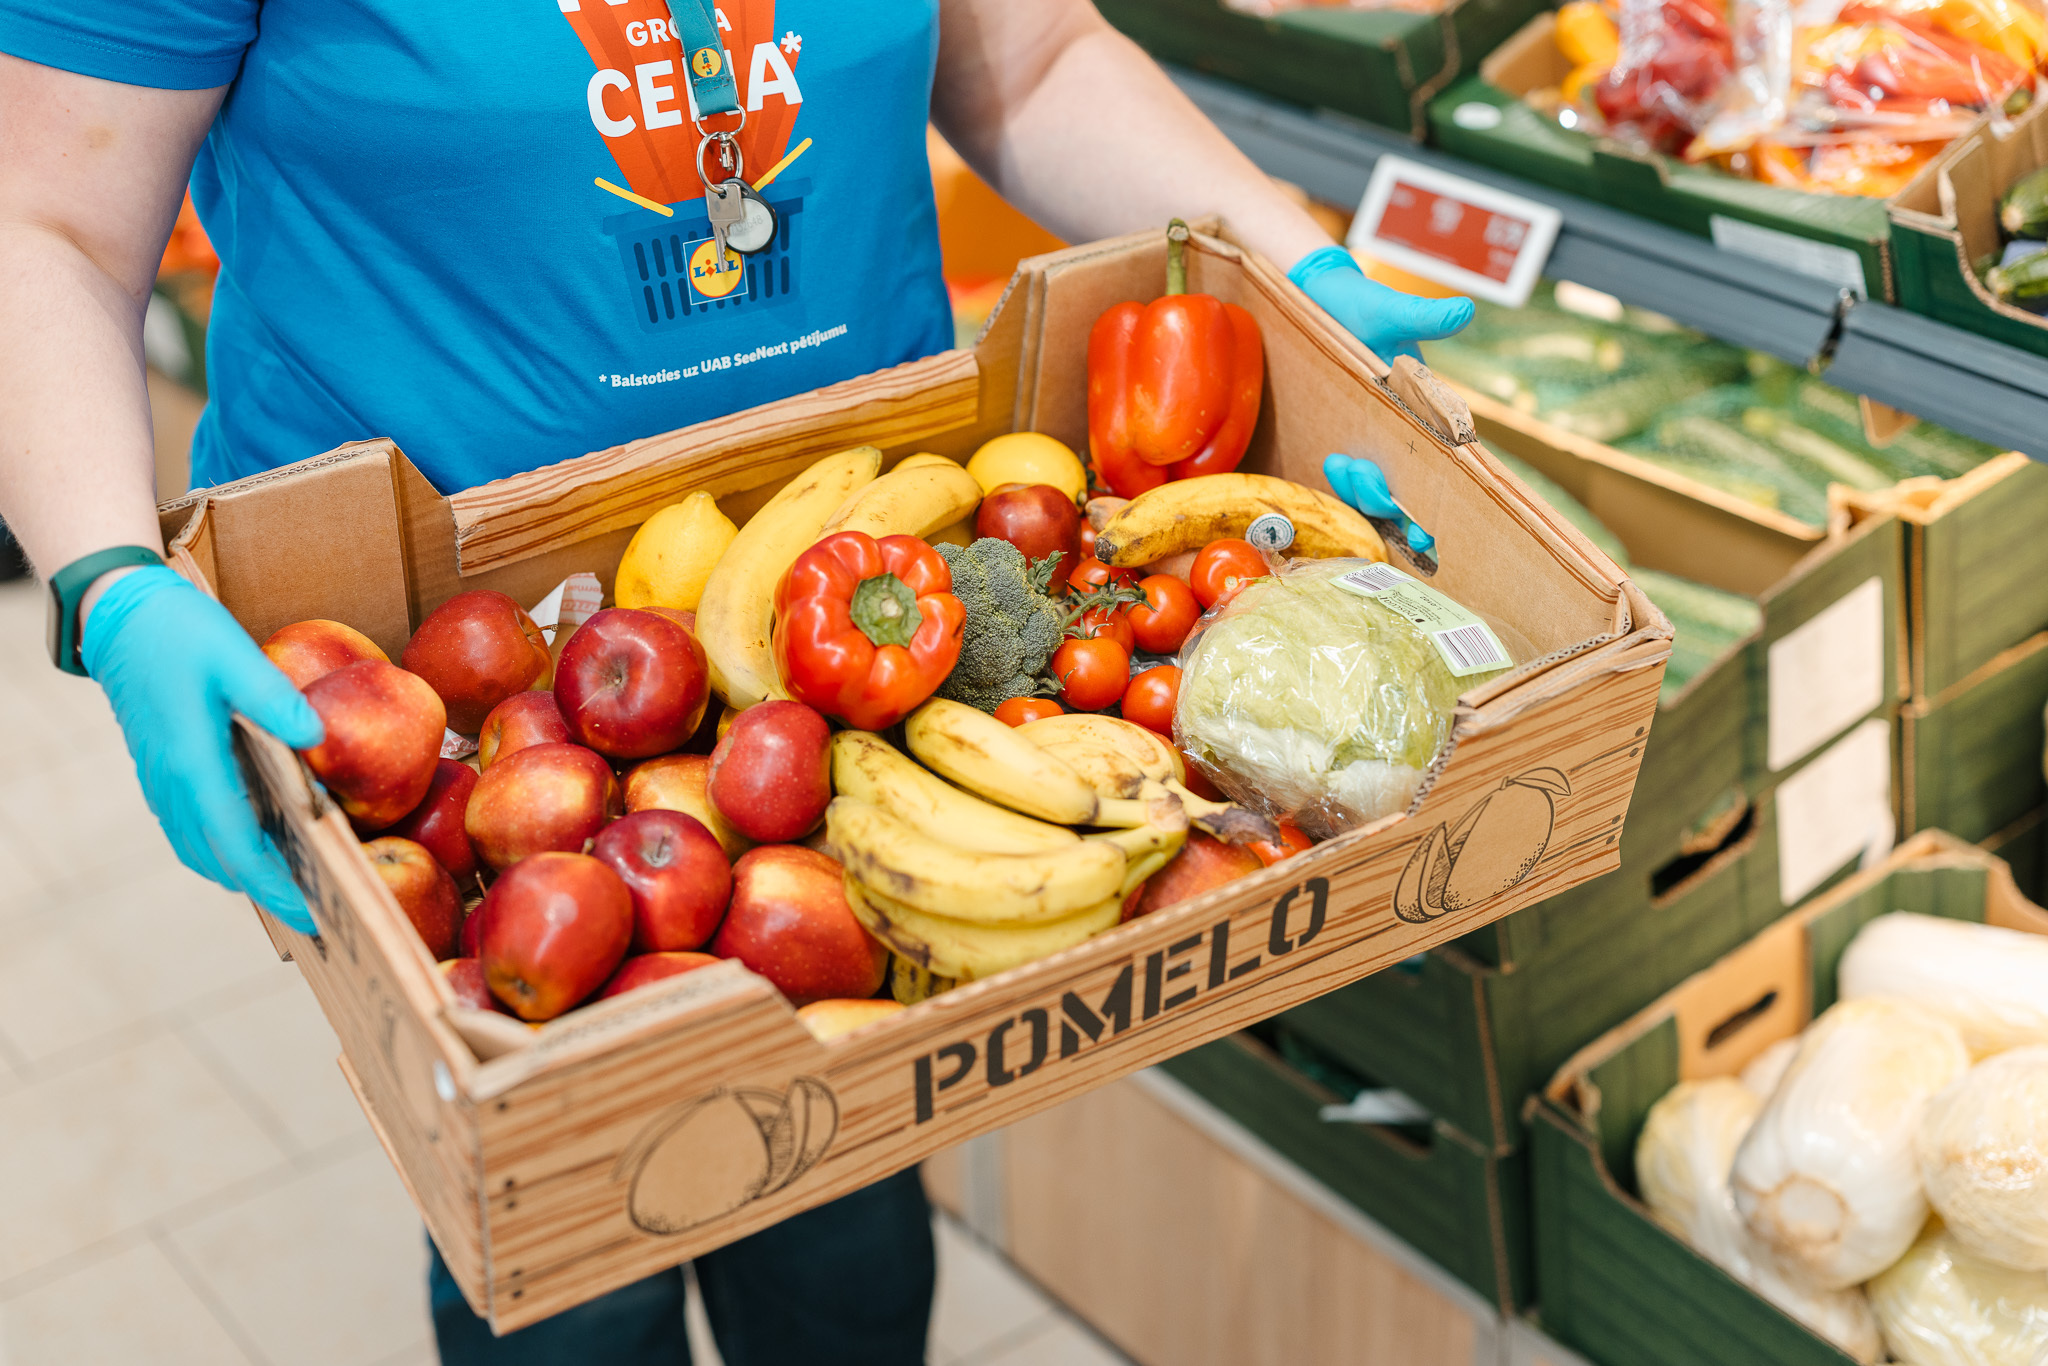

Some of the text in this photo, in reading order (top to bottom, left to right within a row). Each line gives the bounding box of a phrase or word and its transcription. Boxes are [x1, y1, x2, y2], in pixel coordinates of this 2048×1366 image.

[625, 8, 732, 47] GRA
[611, 369, 681, 388] Balstoties
[683, 365, 699, 378] uz
[700, 356, 732, 374] UAB
[734, 341, 788, 366] SeeNext
[790, 323, 848, 354] pētījumu
[914, 877, 1330, 1126] POMELO
